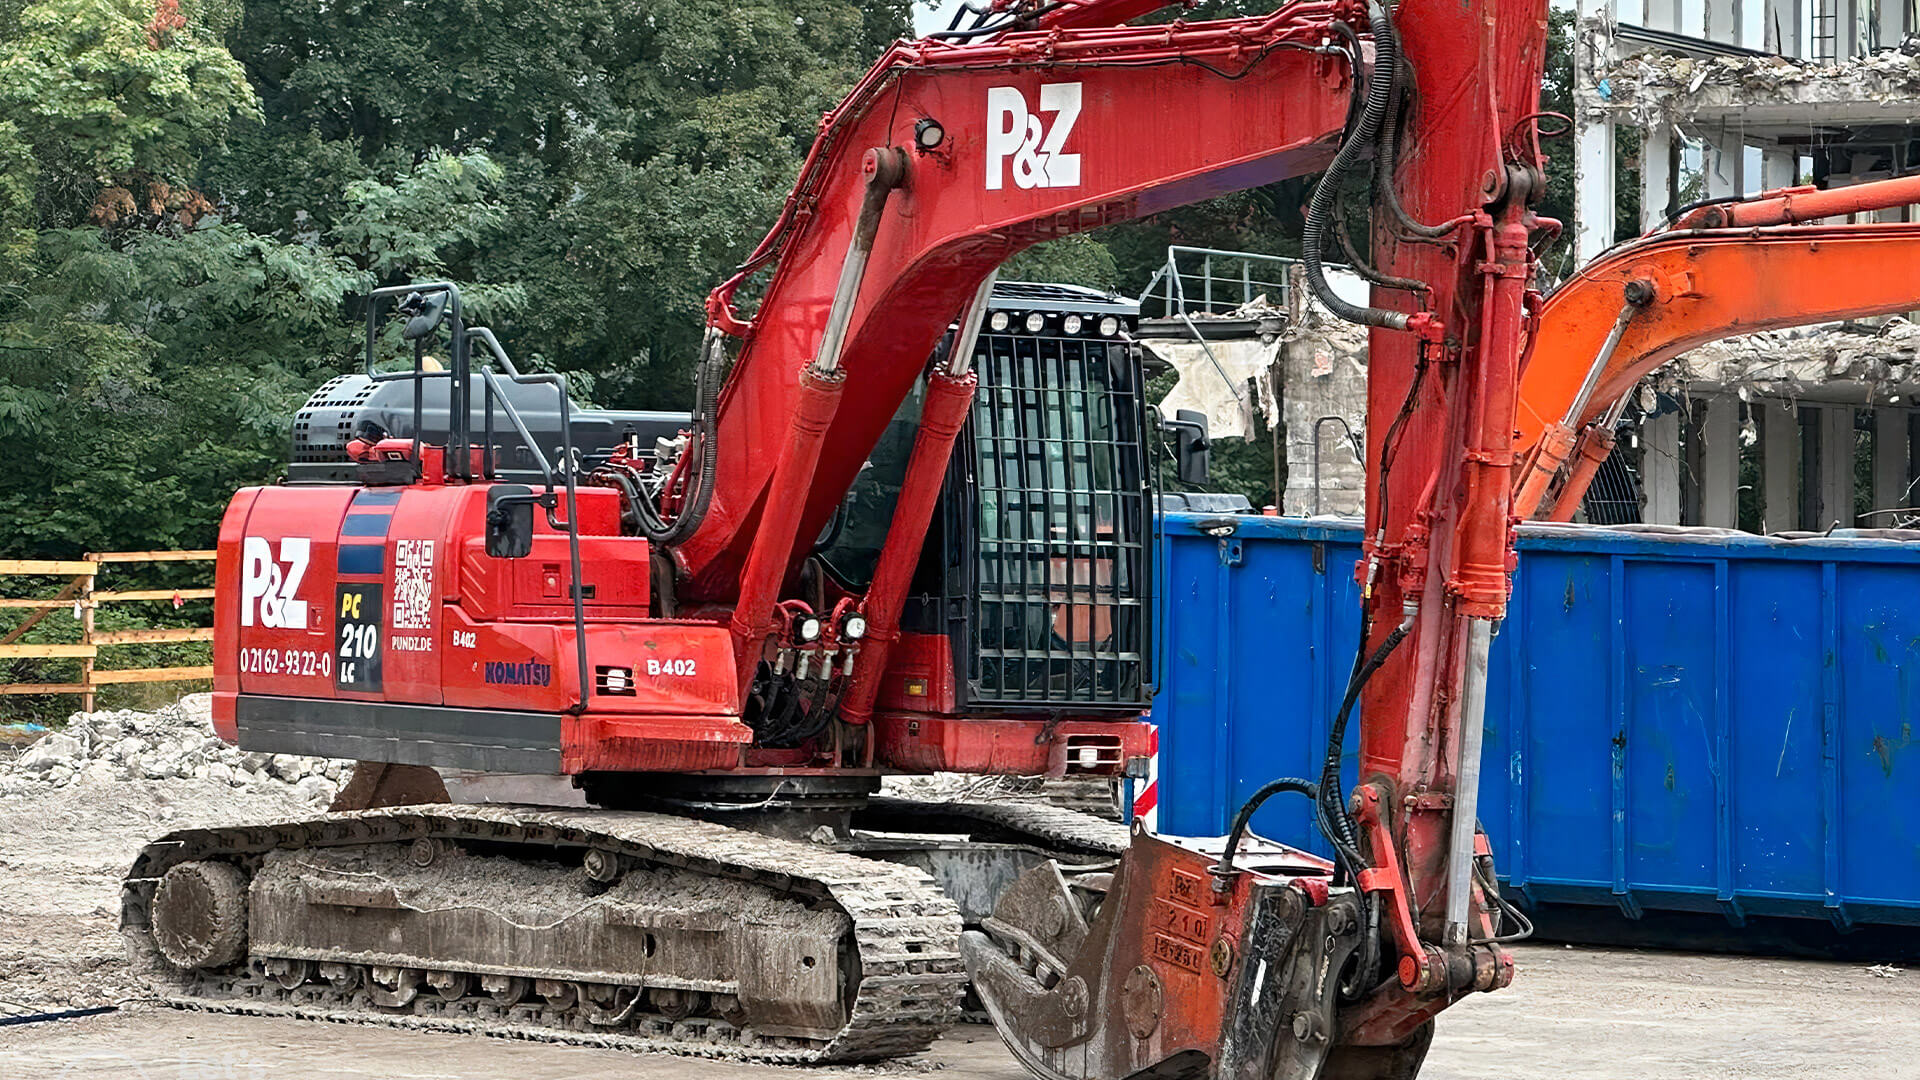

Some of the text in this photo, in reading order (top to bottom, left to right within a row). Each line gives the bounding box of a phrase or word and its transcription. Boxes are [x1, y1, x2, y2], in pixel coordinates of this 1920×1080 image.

[985, 81, 1083, 190] P&Z
[241, 536, 311, 630] P&Z
[340, 593, 362, 620] PC
[339, 623, 377, 659] 210
[391, 635, 433, 652] PUNDZ.DE
[452, 629, 477, 649] B402
[340, 661, 356, 684] LC
[484, 656, 552, 687] KOMATSU
[646, 658, 697, 677] B402
[1167, 907, 1203, 937] 210
